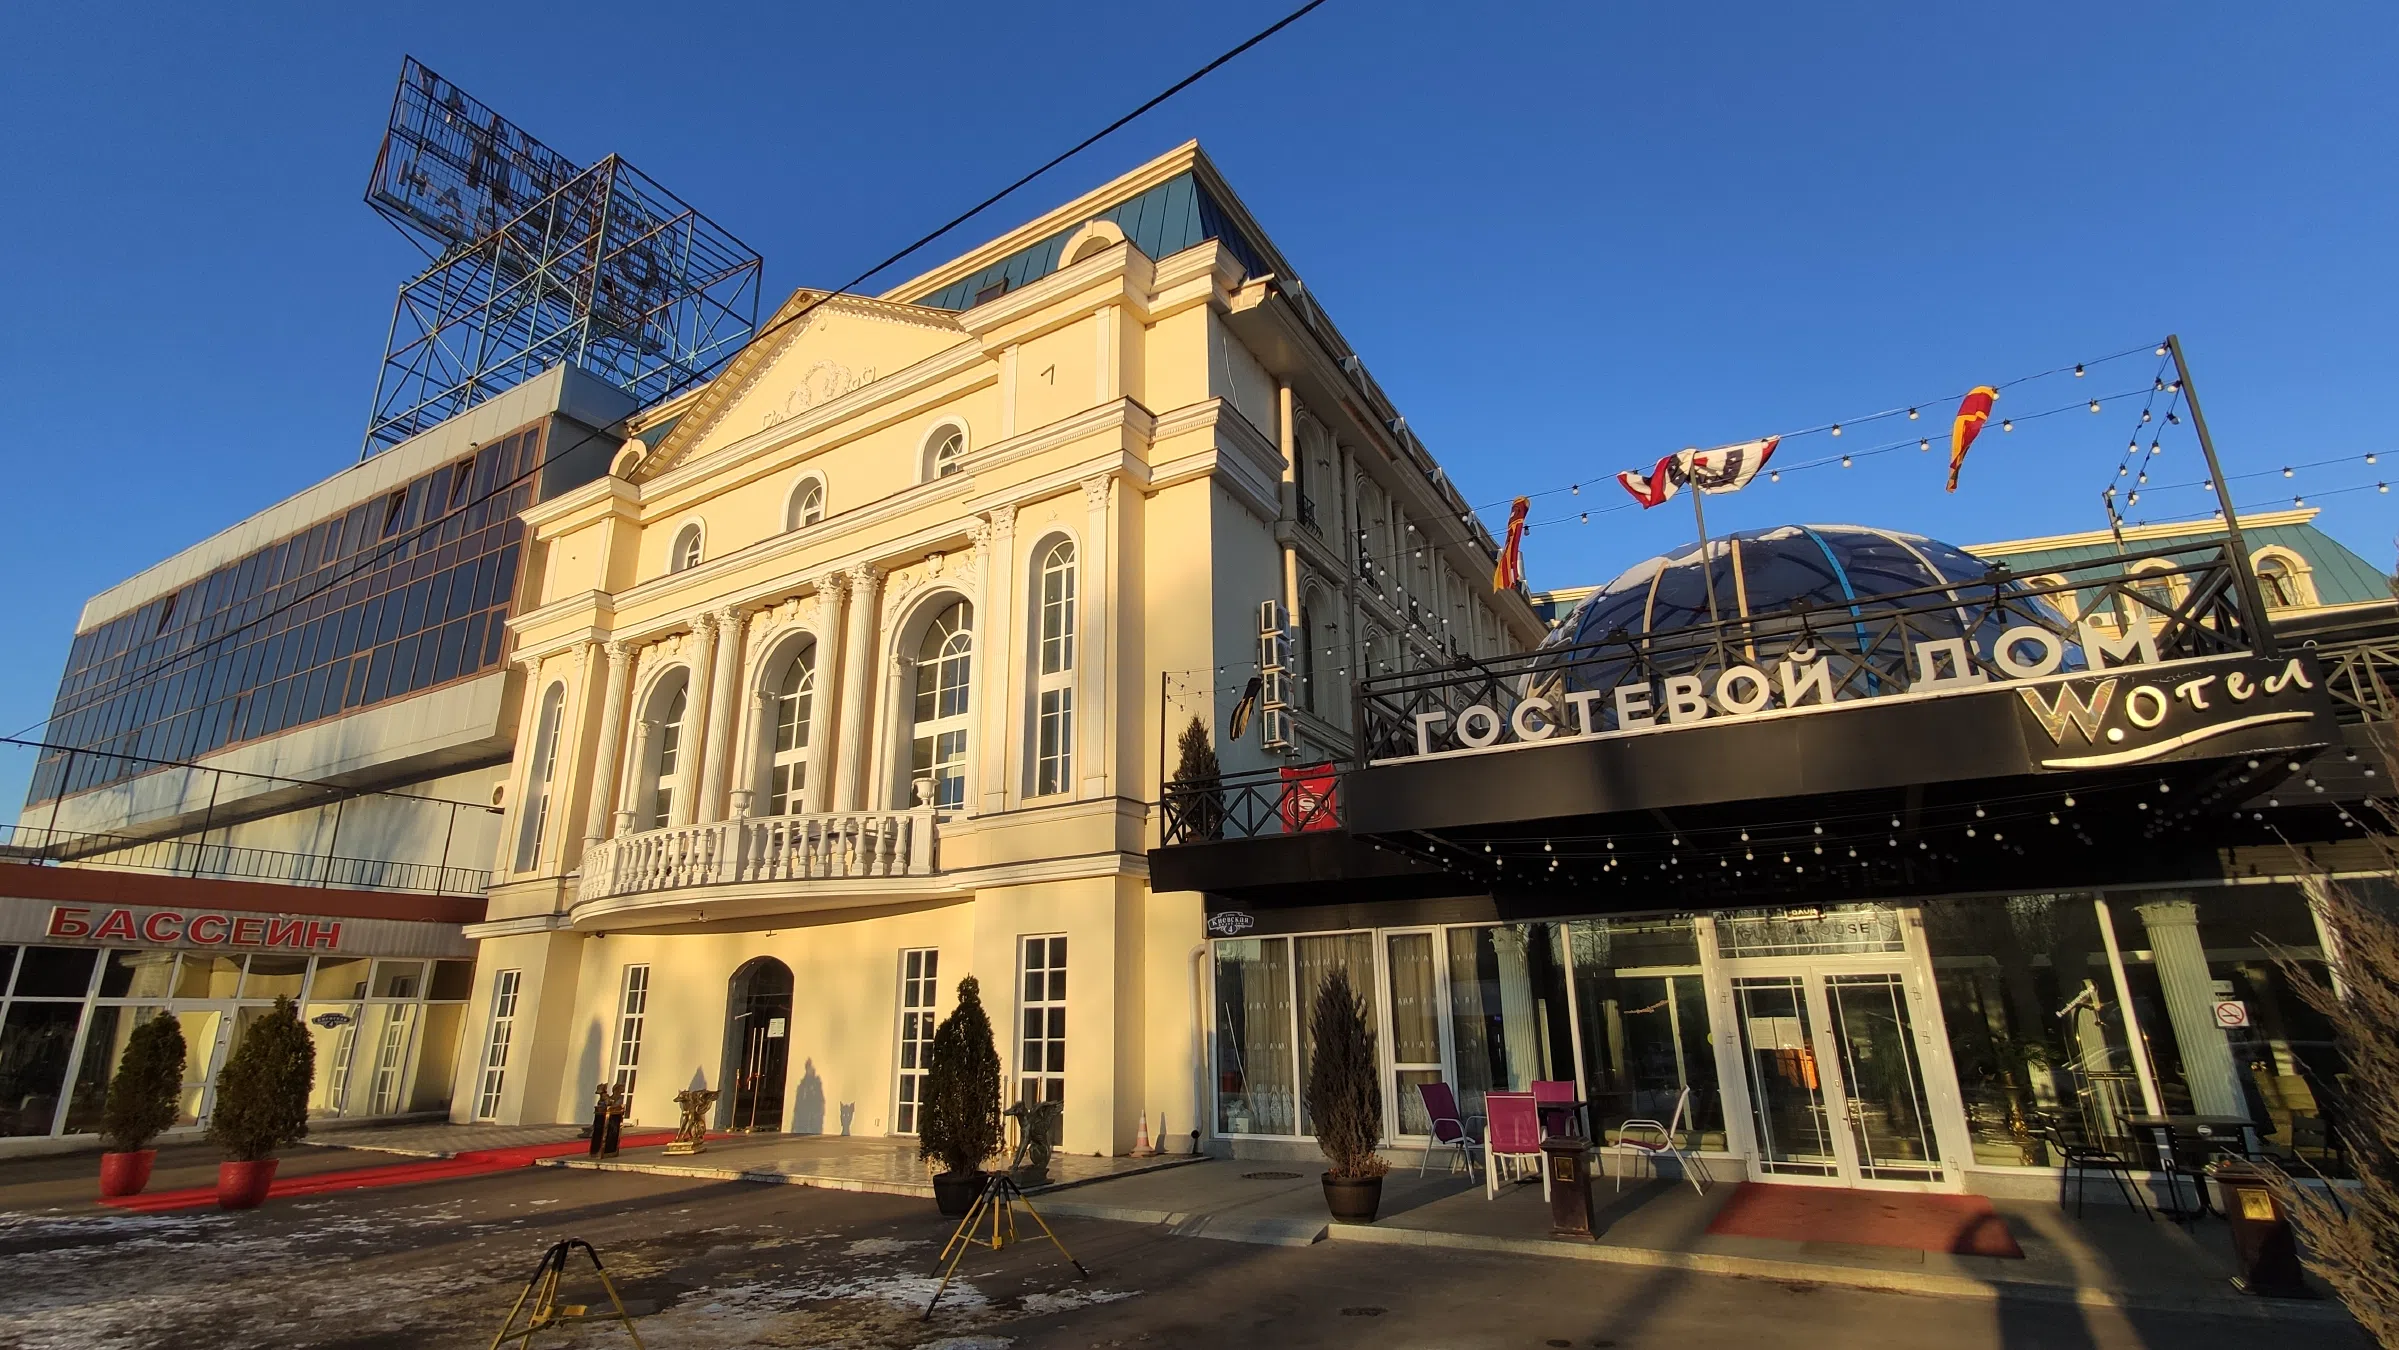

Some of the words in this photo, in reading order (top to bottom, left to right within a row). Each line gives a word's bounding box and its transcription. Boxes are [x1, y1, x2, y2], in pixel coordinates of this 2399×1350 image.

[1416, 648, 1835, 755] ГОСТЕВОЙ
[1908, 613, 2159, 692] ДОМ
[46, 905, 343, 949] БАССЕЙН
